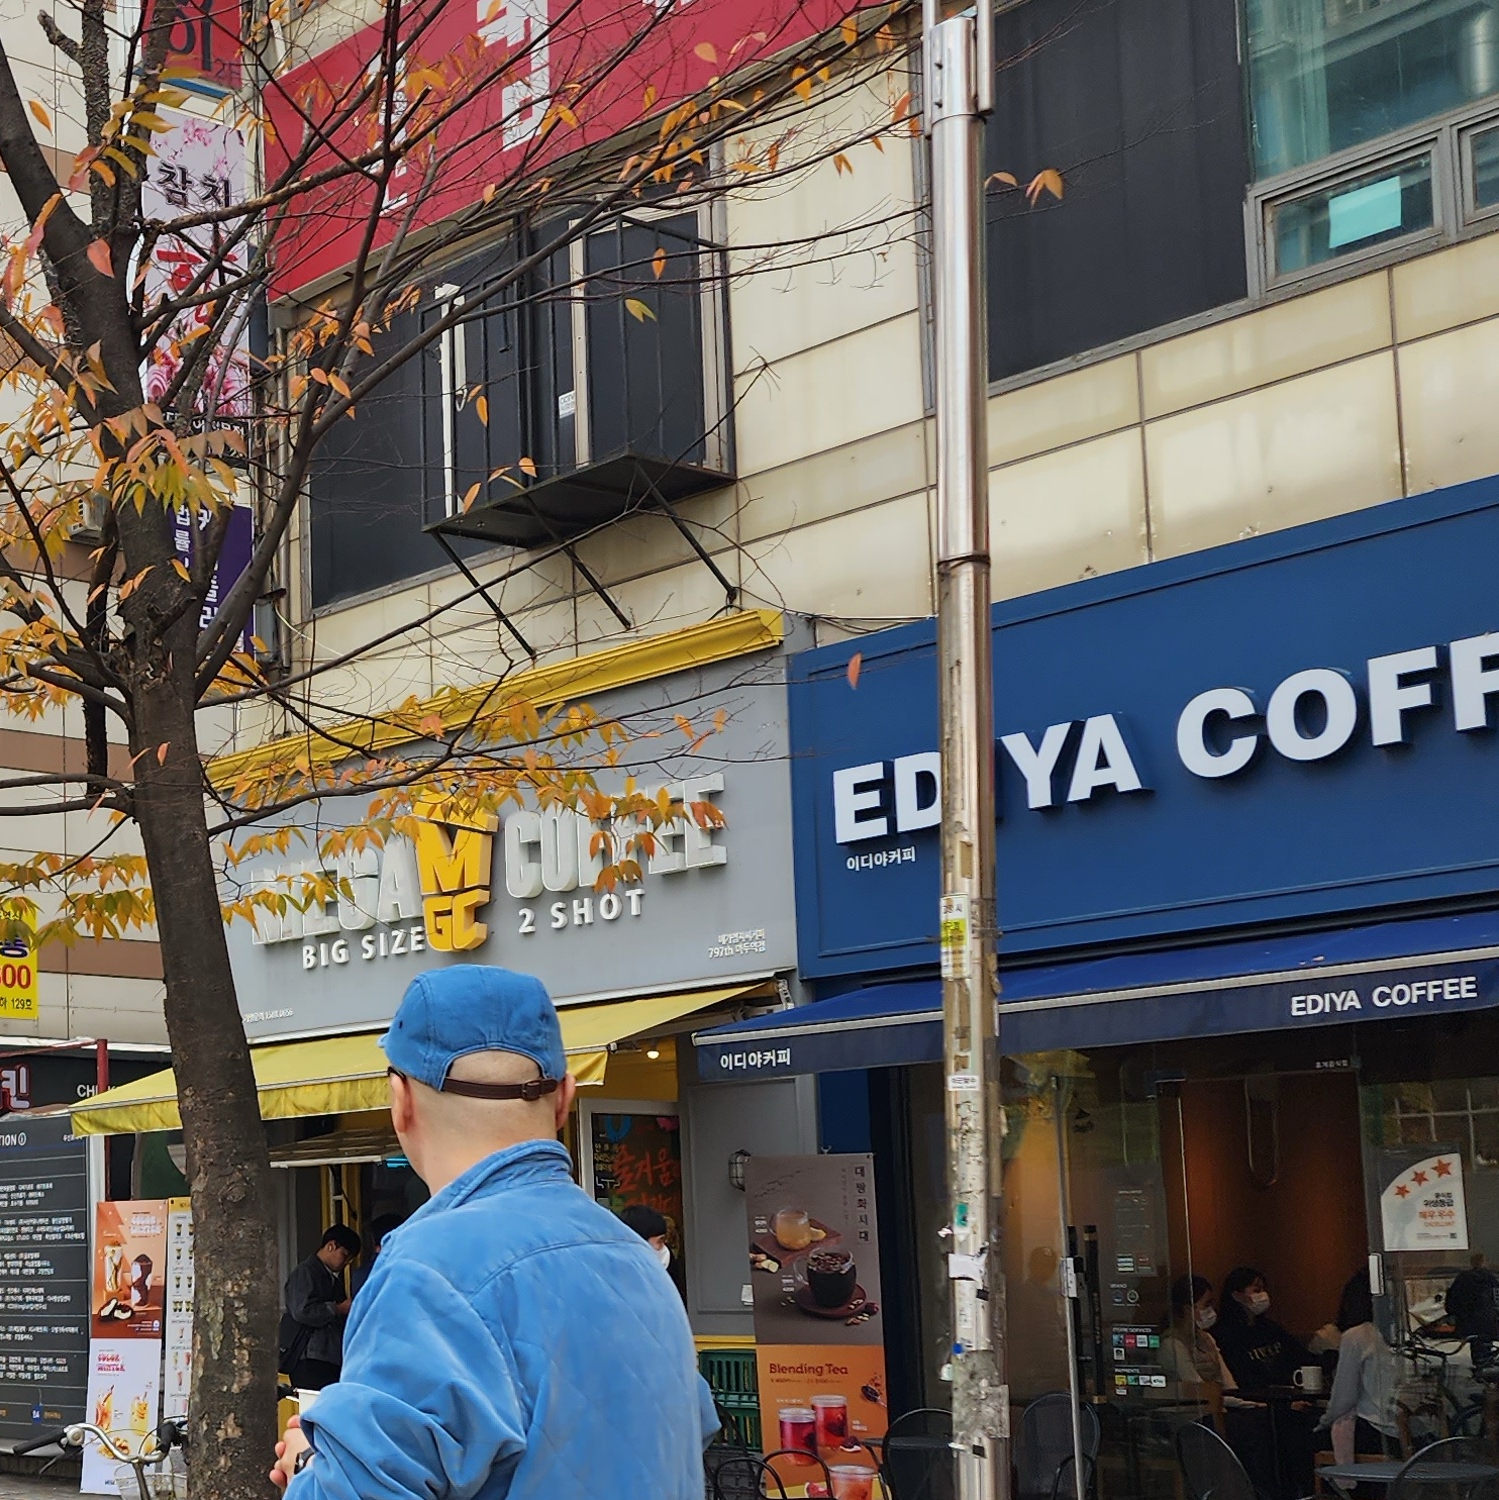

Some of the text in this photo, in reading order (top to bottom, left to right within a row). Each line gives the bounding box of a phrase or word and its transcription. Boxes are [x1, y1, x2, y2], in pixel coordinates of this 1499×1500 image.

[833, 713, 1143, 845] EDYA
[846, 845, 916, 872] 이디야커피
[518, 888, 646, 934] 2 SHOT
[302, 926, 426, 970] BIG SIZE
[11, 997, 33, 1010] 129호
[1291, 976, 1478, 1016] EDIYA COFFEE
[720, 1047, 791, 1071] 이디야커피
[769, 1363, 848, 1376] Blending Tea
